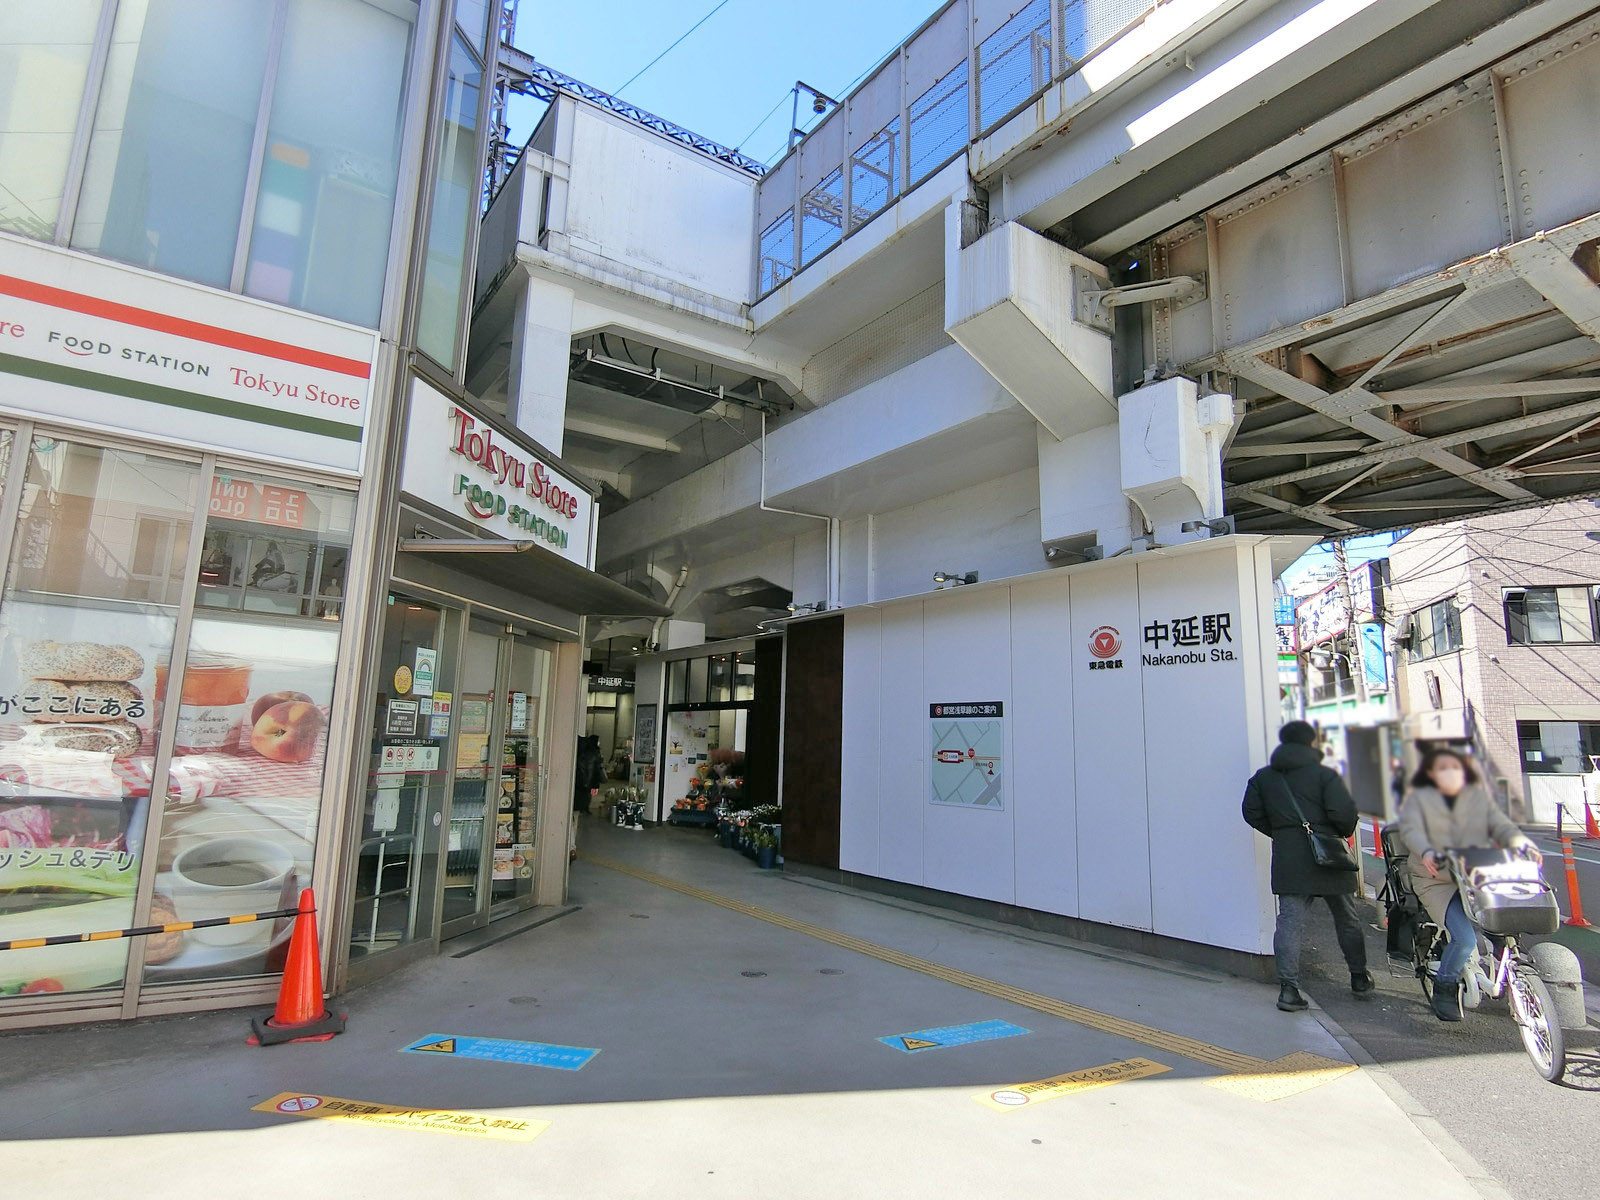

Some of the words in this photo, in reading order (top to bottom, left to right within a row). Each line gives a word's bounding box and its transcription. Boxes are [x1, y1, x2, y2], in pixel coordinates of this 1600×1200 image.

[48, 331, 112, 355] FOOD
[121, 348, 210, 377] STATION
[229, 367, 299, 397] Tokyu
[304, 384, 361, 410] Store
[448, 407, 525, 488] Tokyu
[526, 462, 577, 518] Store
[453, 474, 506, 515] FOOD
[507, 504, 568, 548] STATION
[1143, 612, 1233, 650] 中延駅
[1088, 660, 1124, 671] 東急電鉄
[1142, 650, 1206, 667] Nakanobu
[1210, 648, 1238, 662] Sta.
[597, 676, 623, 687] 中延駅
[322, 1100, 530, 1131] 自転車・バイク進入禁止
[422, 1121, 488, 1134] Motorcycles
